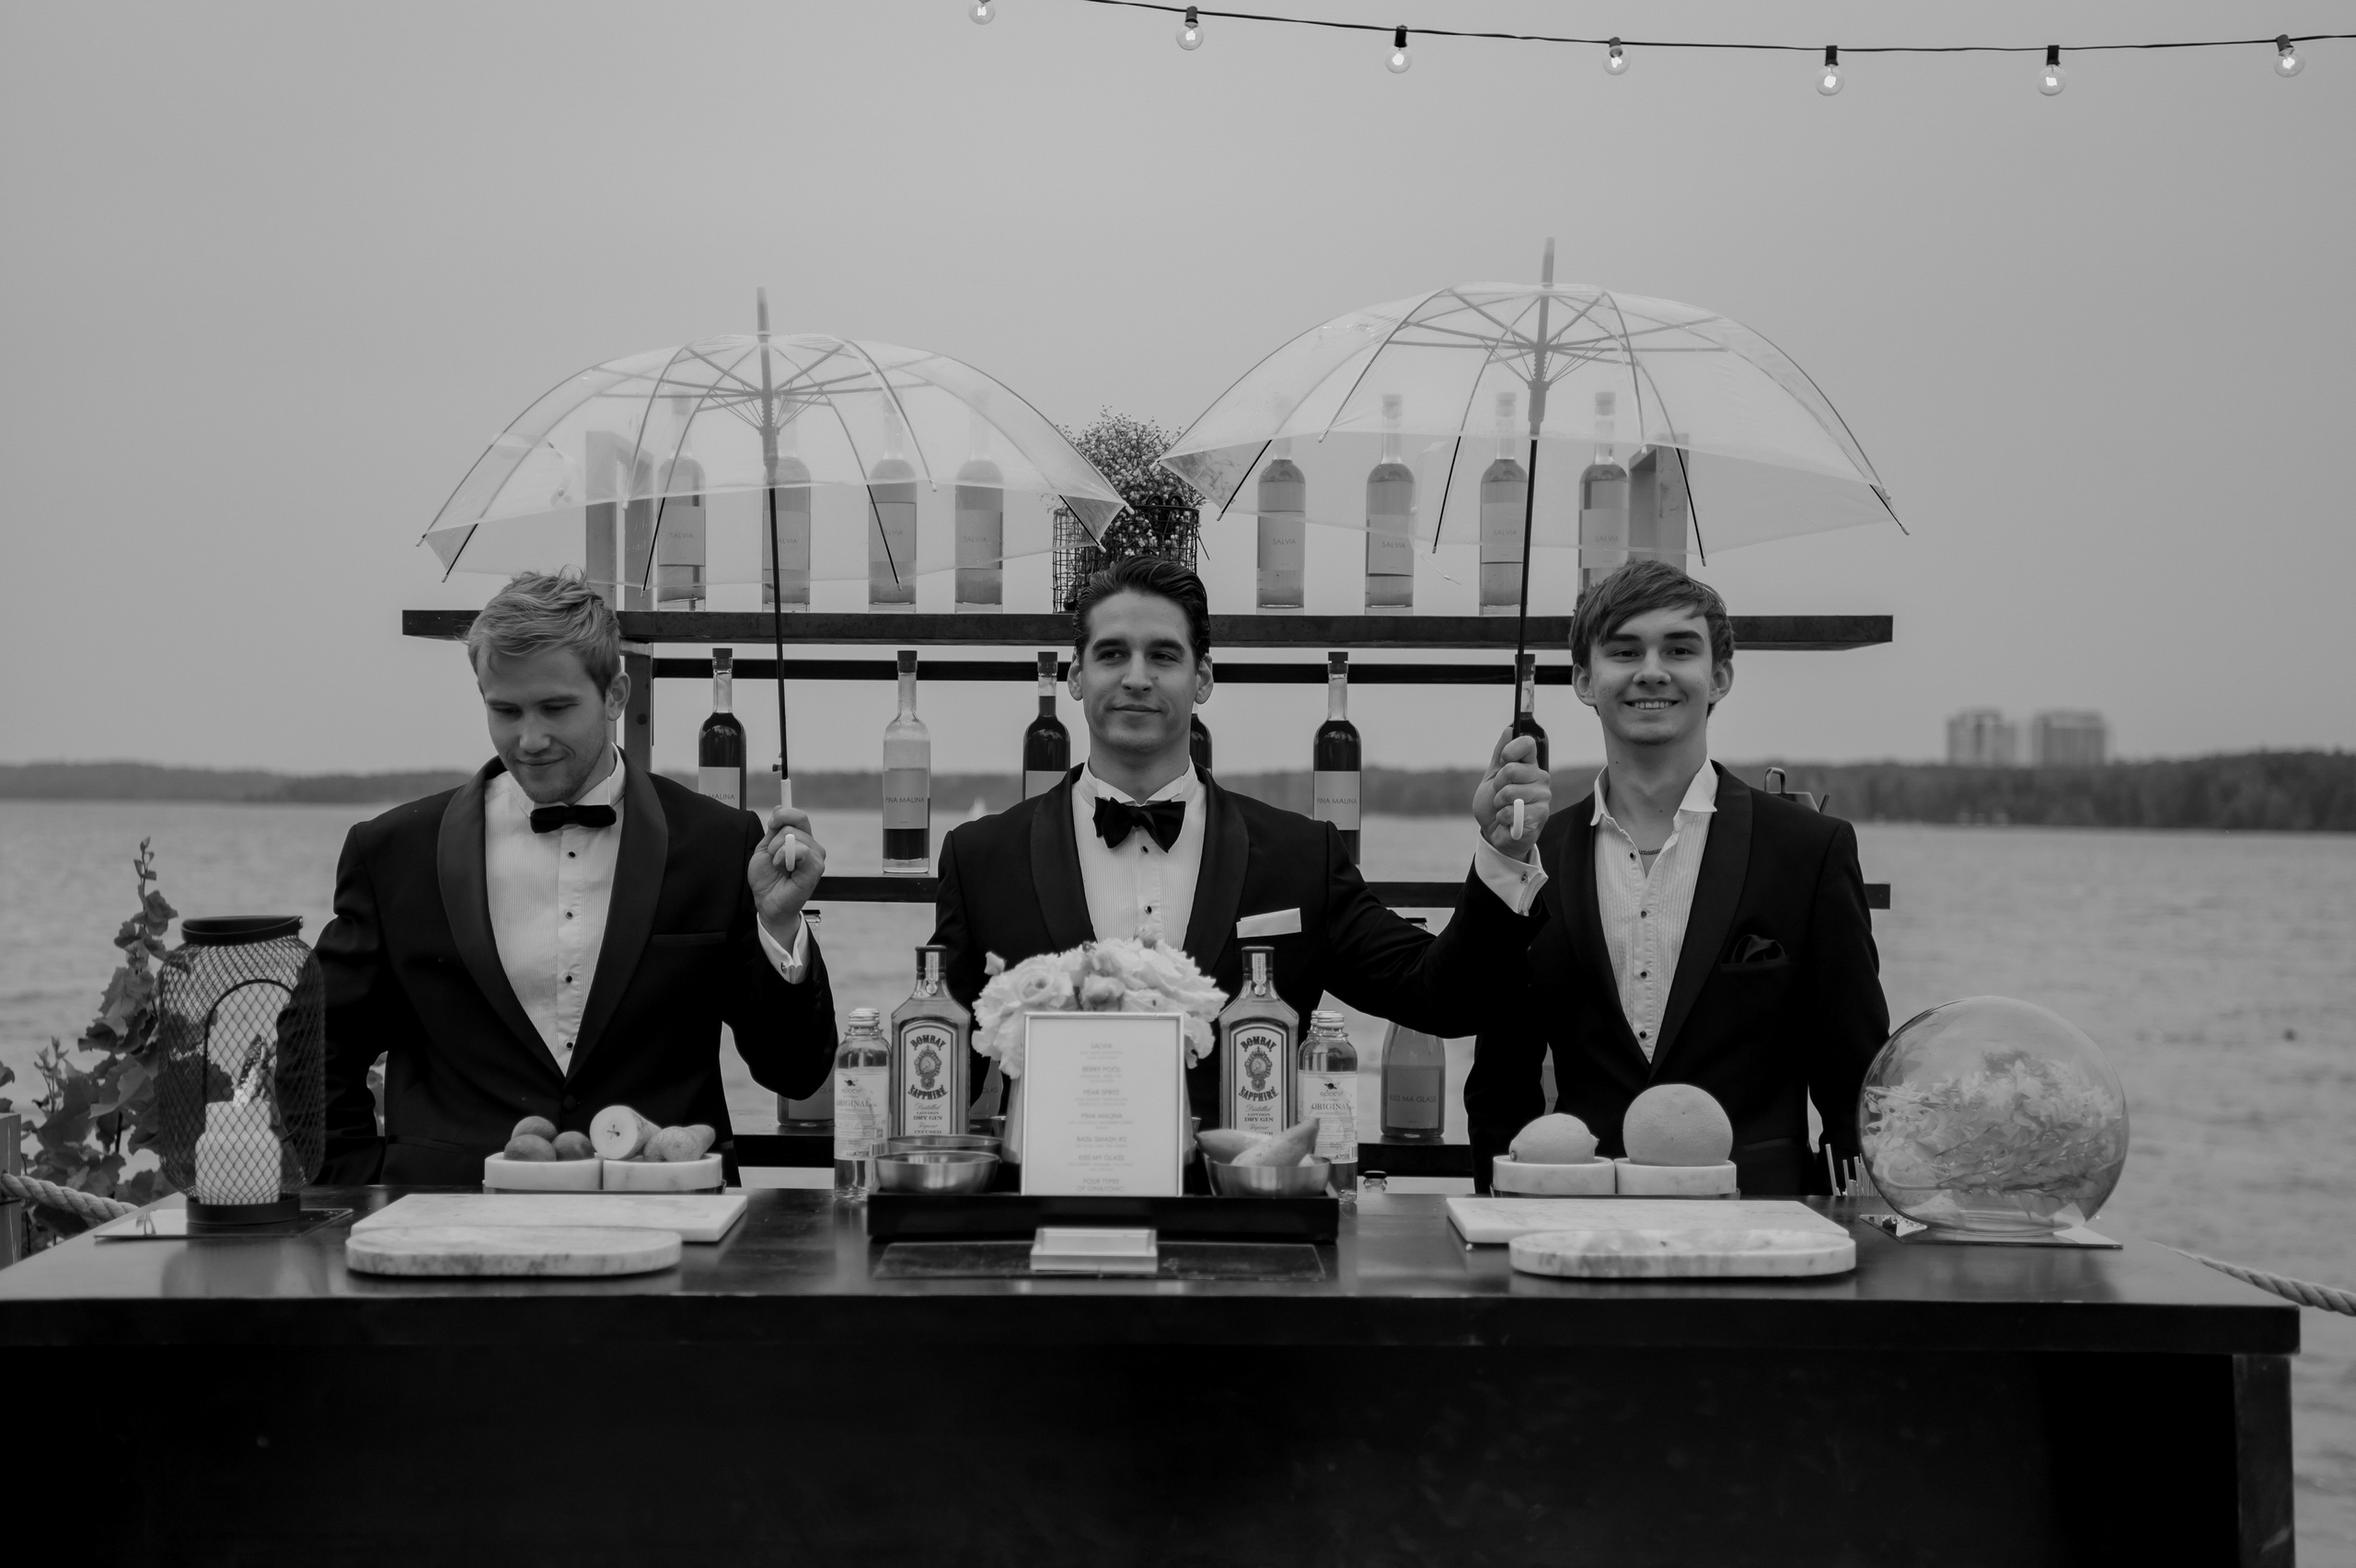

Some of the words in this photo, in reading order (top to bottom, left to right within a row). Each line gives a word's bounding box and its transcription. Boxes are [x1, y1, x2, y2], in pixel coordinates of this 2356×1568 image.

[909, 1034, 947, 1051] BOMBAY
[1240, 1036, 1277, 1053] BOMBAY
[907, 1084, 947, 1100] SAPPHIRE
[1238, 1086, 1278, 1101] SAPPHIRE
[913, 1102, 941, 1111] Distilled
[1244, 1104, 1274, 1113] Distilled
[1311, 1102, 1350, 1111] ORIGINAL
